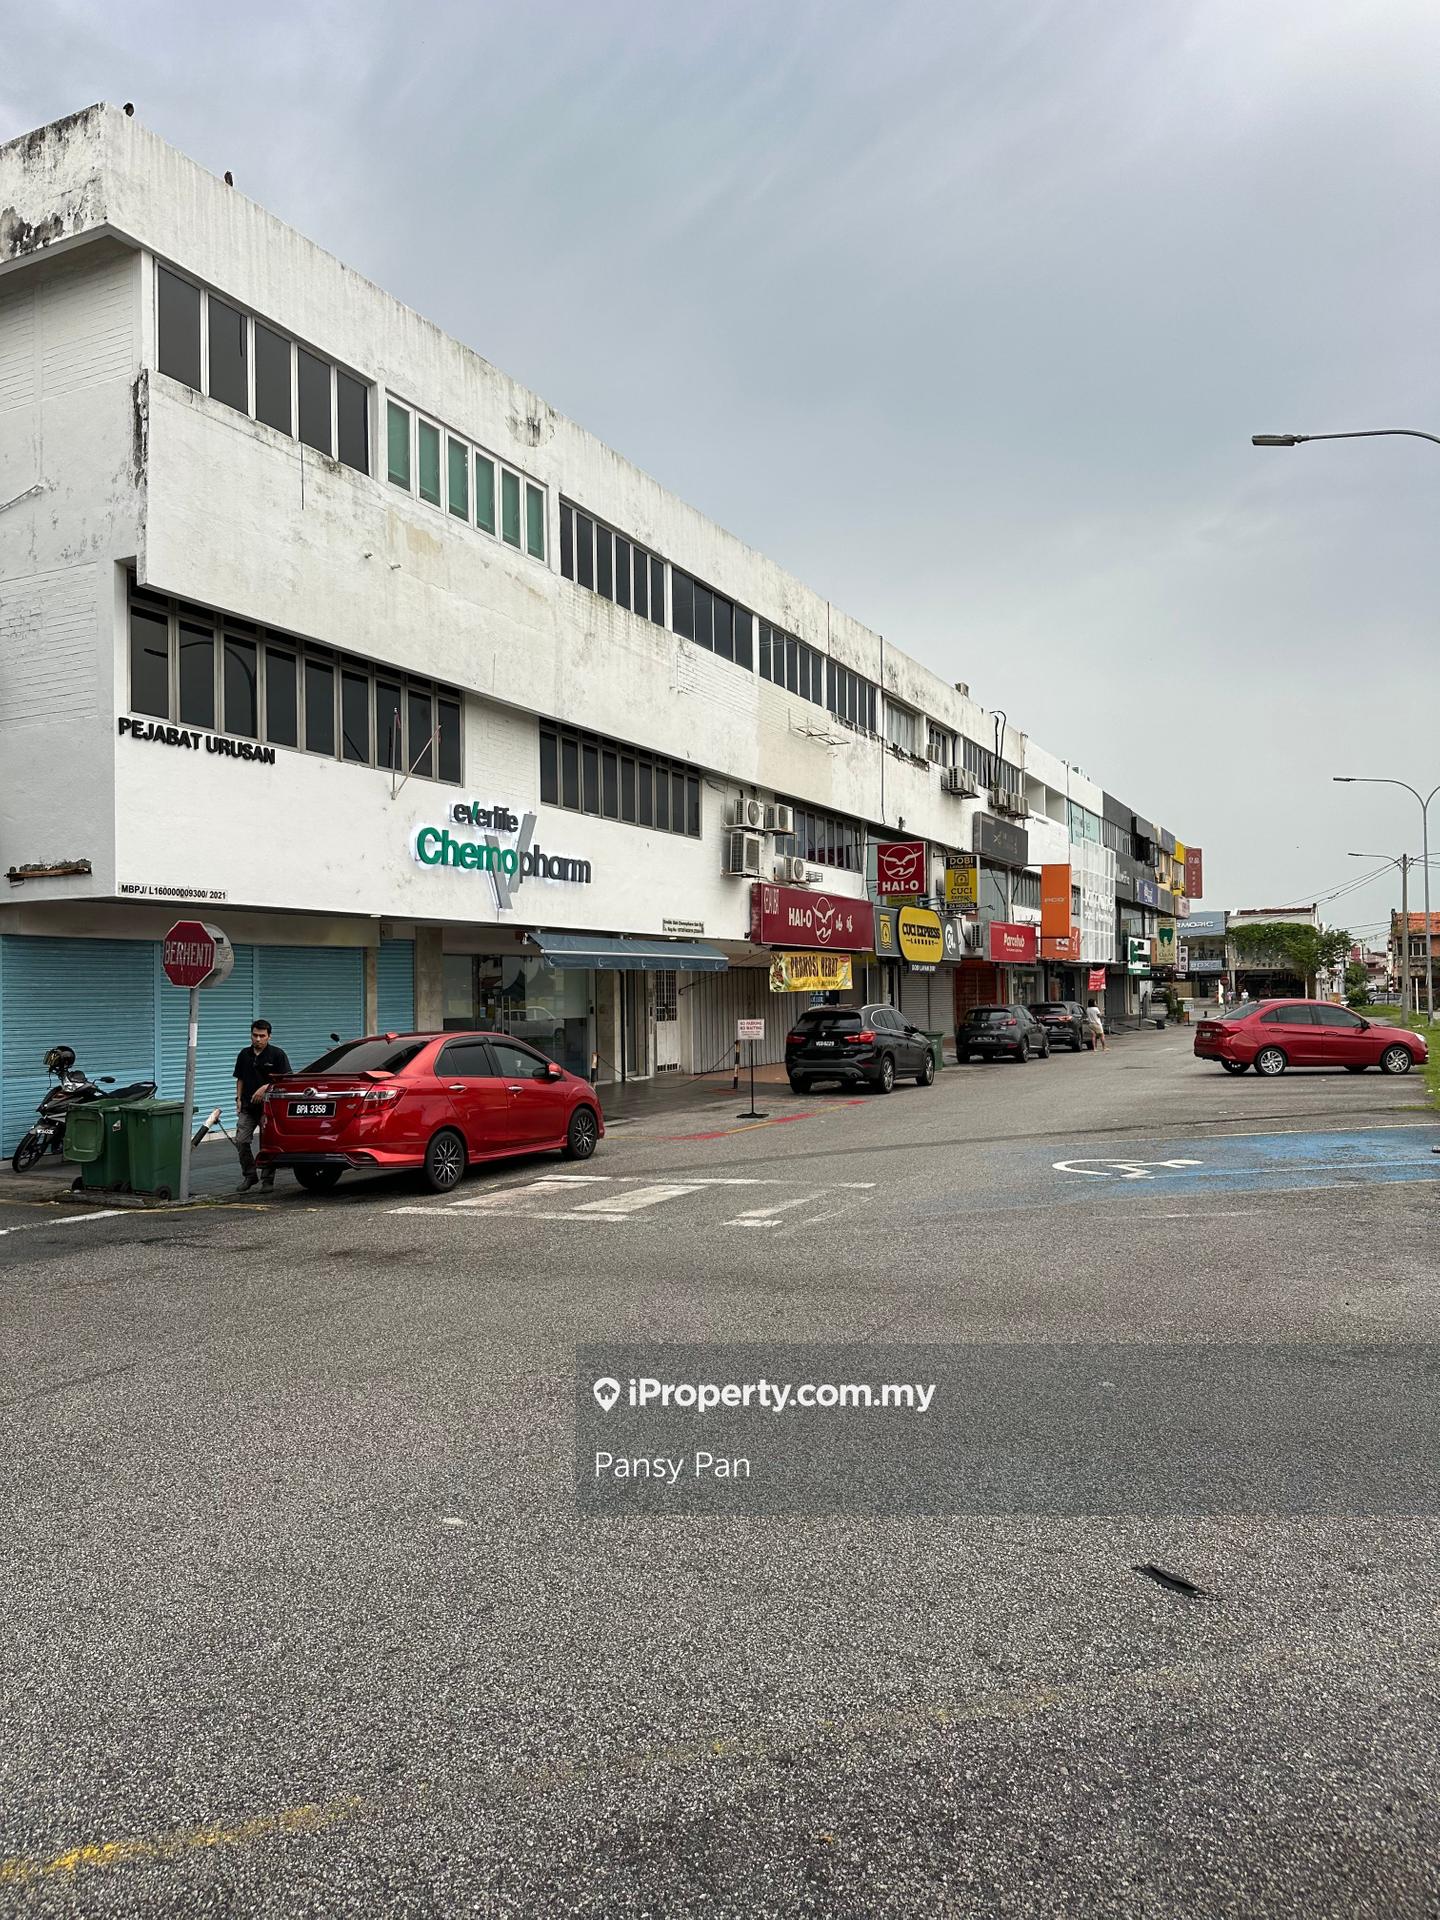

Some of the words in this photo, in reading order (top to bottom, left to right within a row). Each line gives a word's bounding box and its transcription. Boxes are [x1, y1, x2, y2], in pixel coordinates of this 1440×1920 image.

[118, 717, 203, 750] PEJABAT
[205, 735, 276, 764] URUSAN
[453, 800, 519, 832] everlife
[950, 857, 973, 865] DOBI
[121, 884, 147, 895] MBPJ/
[209, 891, 226, 900] 2021
[882, 880, 919, 892] HAI-O
[788, 907, 812, 928] HAI-O
[902, 923, 916, 936] CUCI
[917, 925, 940, 939] EXPRESS
[164, 941, 212, 968] BERHENTI
[296, 1105, 308, 1114] BPA
[309, 1105, 327, 1114] 3358
